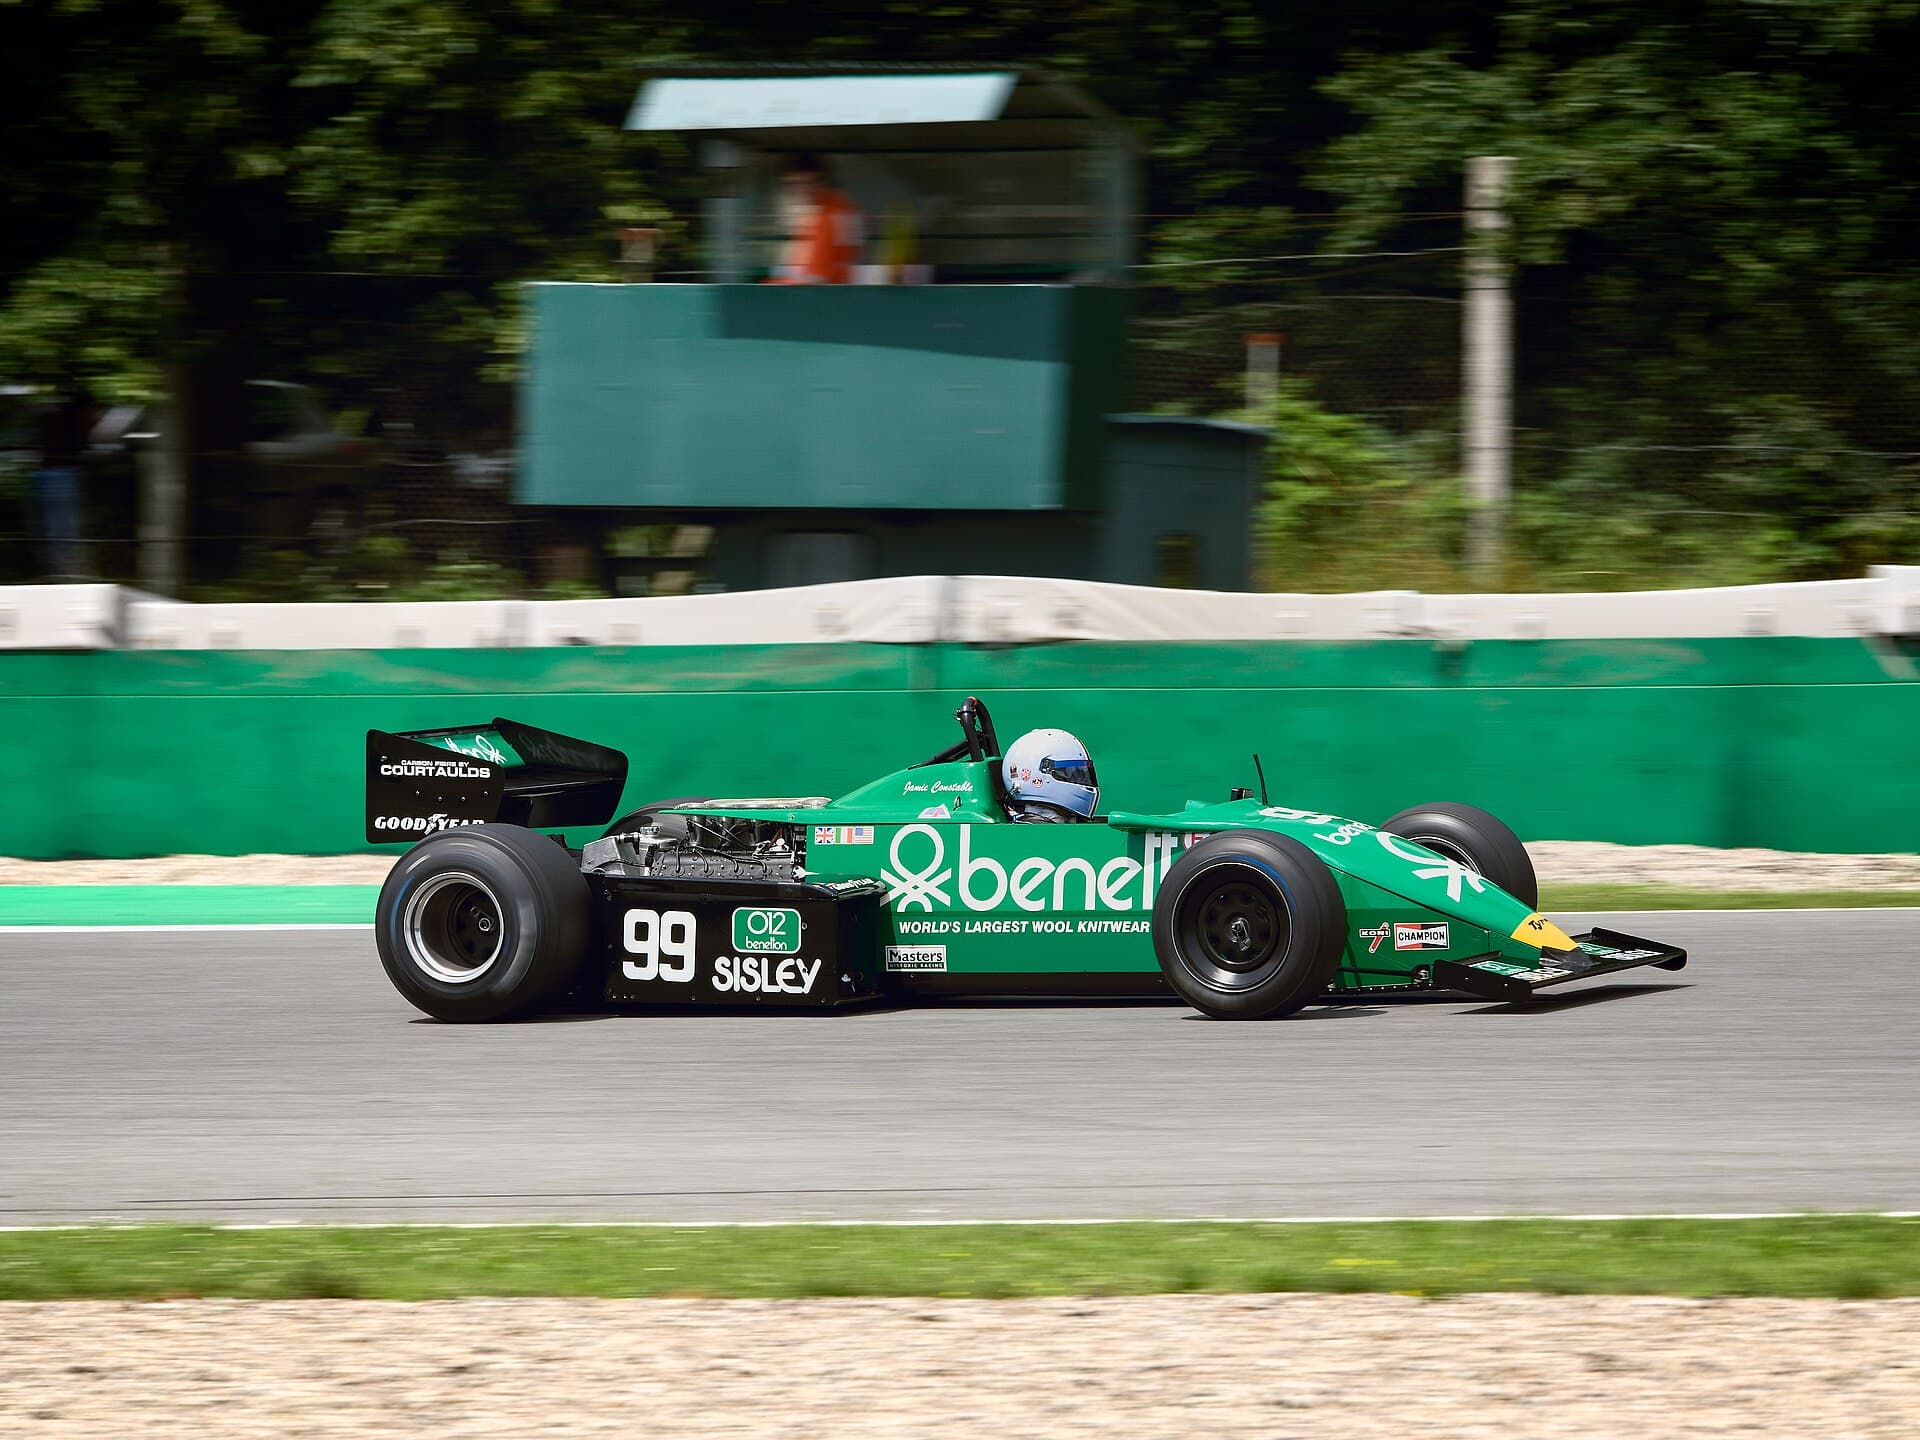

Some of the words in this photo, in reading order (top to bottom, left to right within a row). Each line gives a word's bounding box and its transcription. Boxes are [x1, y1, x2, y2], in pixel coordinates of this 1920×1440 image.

[380, 764, 491, 778] COURTAULDS
[902, 781, 929, 795] Jamie
[930, 781, 974, 794] Constable
[958, 824, 1178, 912] benett
[899, 921, 961, 934] WORLD'S
[964, 921, 1029, 933] LARGEST
[1032, 921, 1074, 933] WOOL
[1077, 921, 1150, 933] KNITWEAR
[745, 935, 788, 951] benetton
[1398, 931, 1445, 941] CHAMPION
[622, 908, 697, 983] 99
[889, 949, 943, 962] Masters
[711, 956, 822, 994] SISLEY
